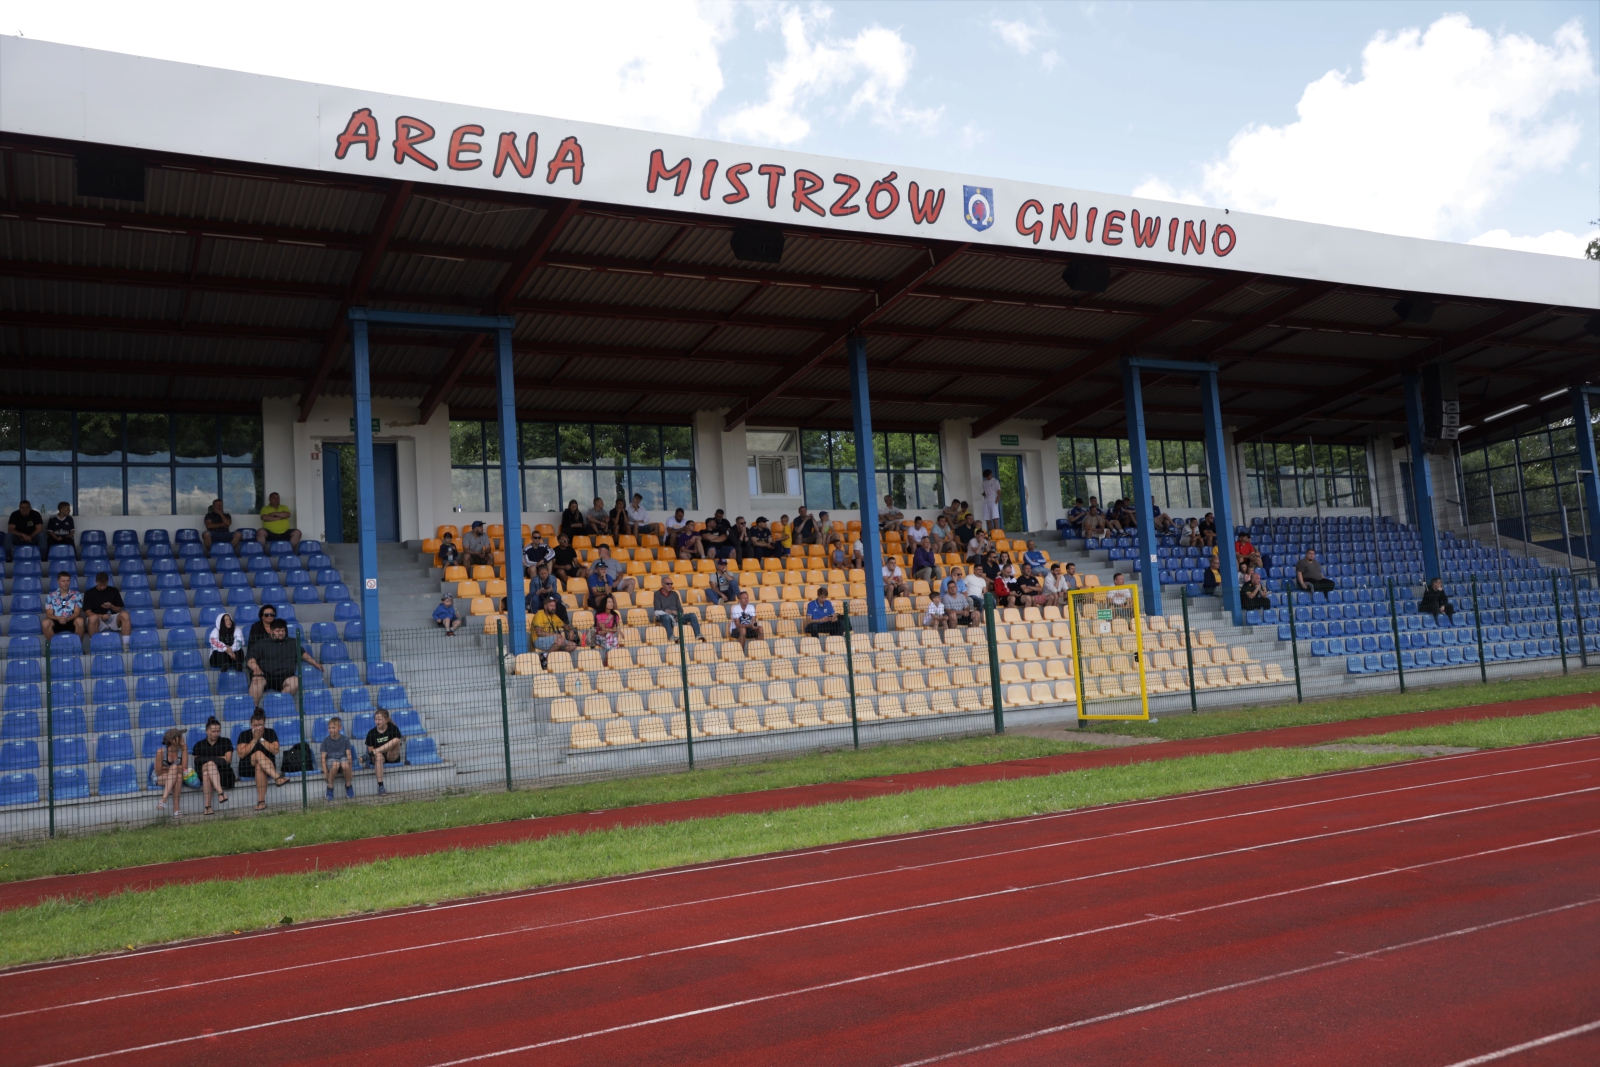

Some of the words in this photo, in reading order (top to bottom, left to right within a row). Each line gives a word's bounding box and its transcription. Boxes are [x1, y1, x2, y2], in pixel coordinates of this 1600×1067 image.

[335, 108, 585, 185] ARENA
[647, 149, 945, 225] MISTRZÓW
[1016, 199, 1236, 257] GNIEWINO
